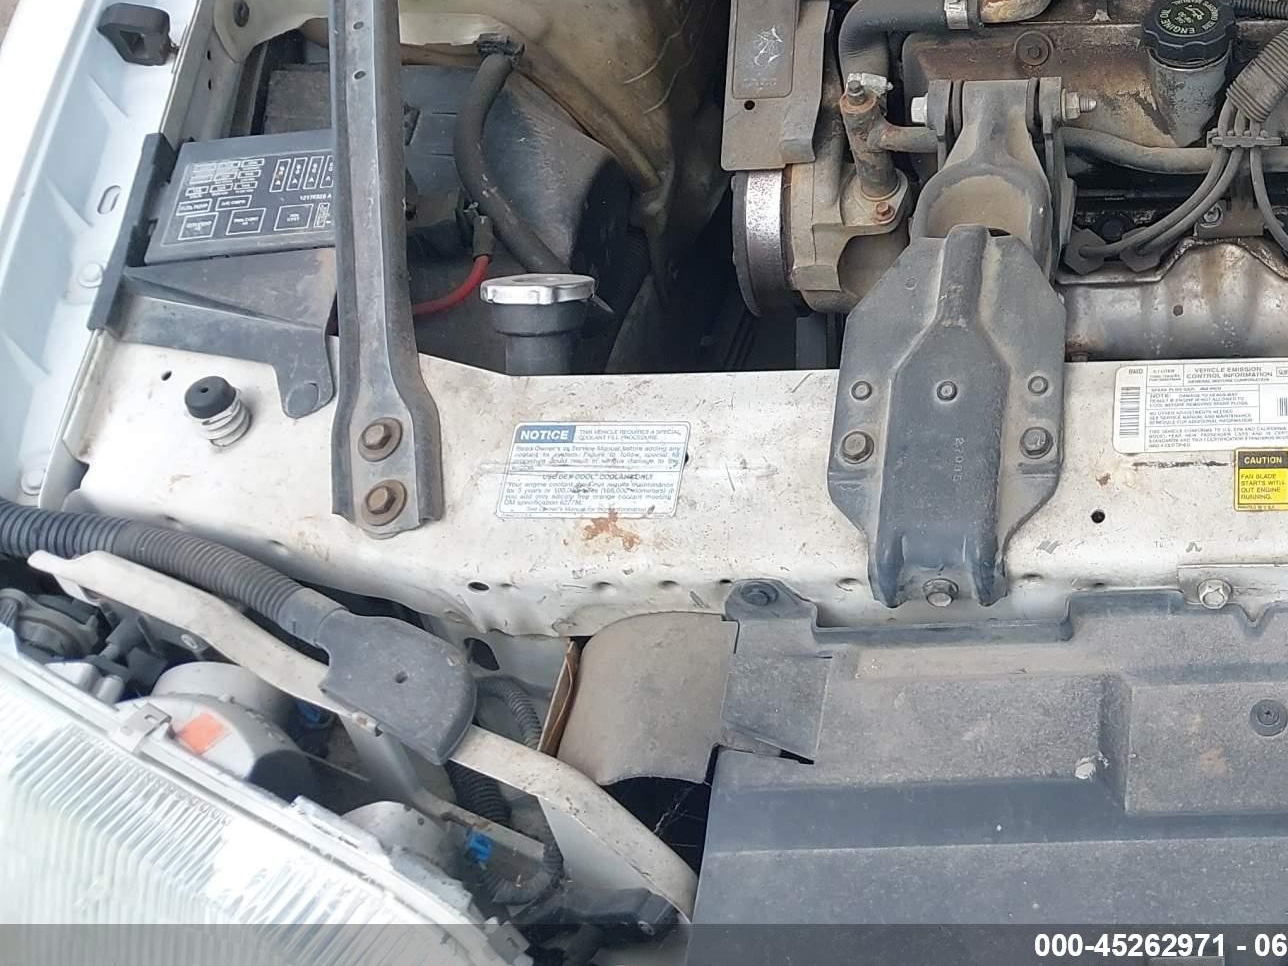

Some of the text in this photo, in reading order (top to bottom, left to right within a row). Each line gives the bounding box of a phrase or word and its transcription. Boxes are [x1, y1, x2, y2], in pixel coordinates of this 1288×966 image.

[1160, 19, 1195, 34] ENGINE
[520, 430, 569, 440] NOTICE
[1243, 456, 1283, 464] CAUTION
